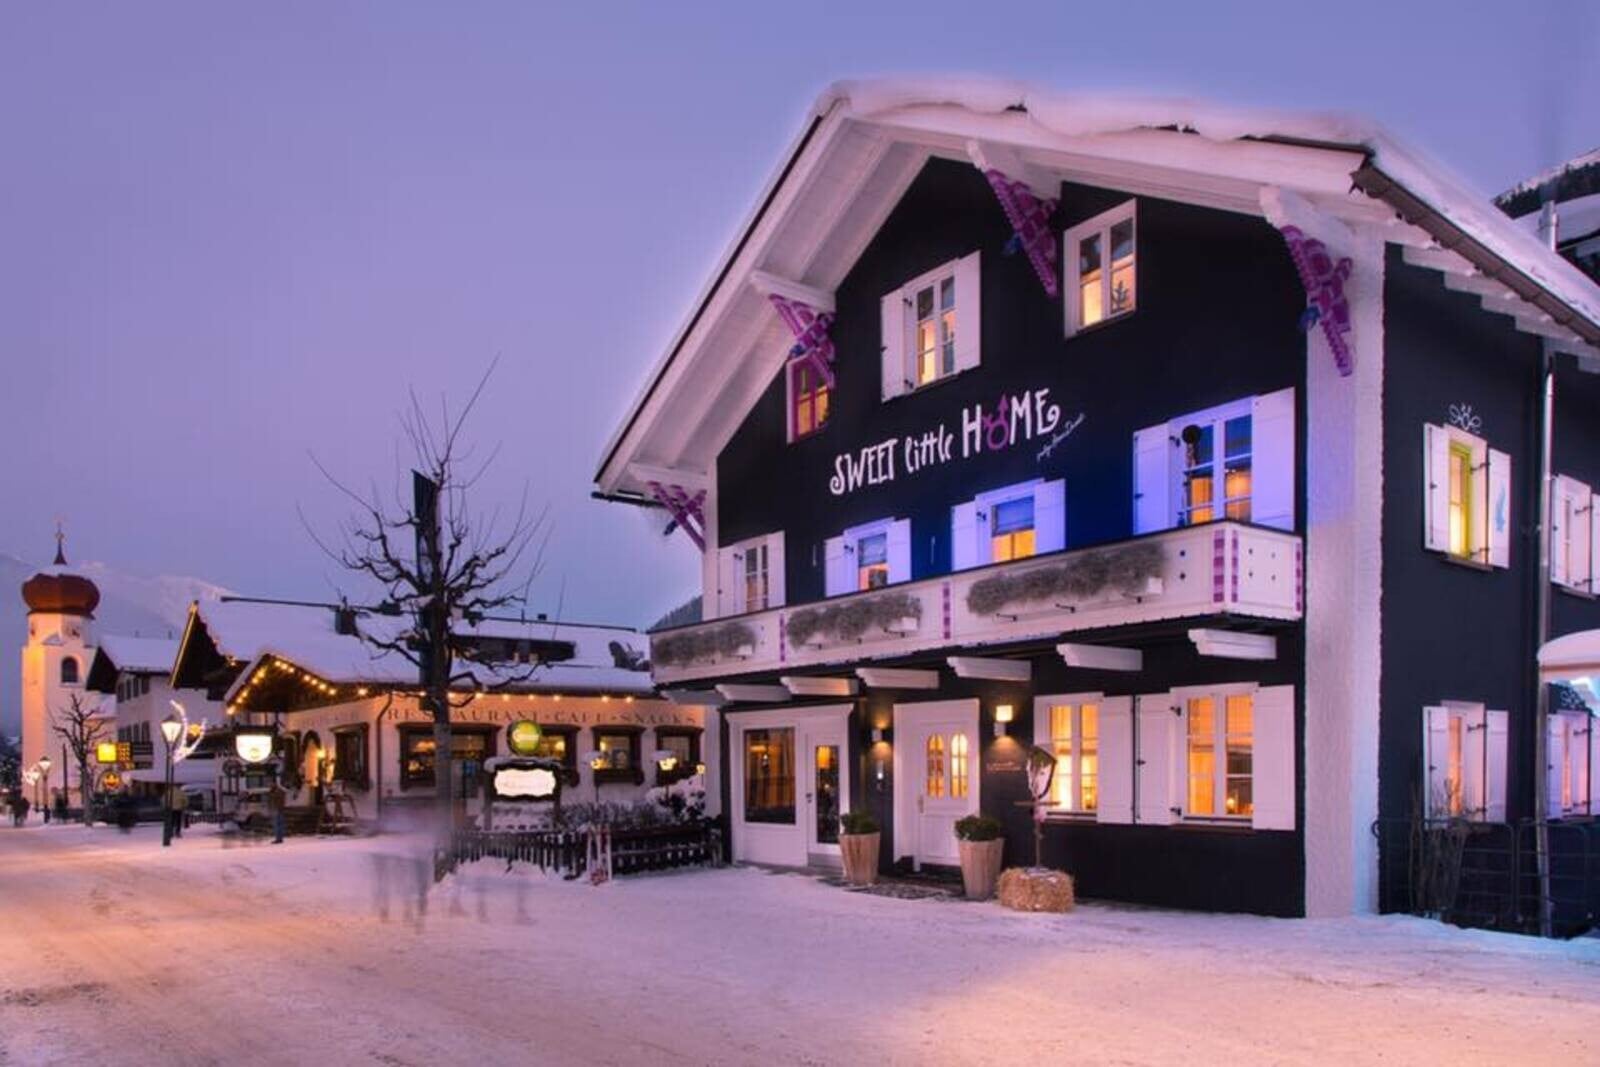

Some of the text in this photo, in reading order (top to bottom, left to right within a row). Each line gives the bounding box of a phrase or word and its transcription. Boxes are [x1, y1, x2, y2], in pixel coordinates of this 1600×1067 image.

[830, 438, 899, 495] SWEET
[905, 424, 955, 474] little
[962, 387, 1062, 459] HOME
[387, 708, 539, 723] RESAURANT
[619, 711, 697, 725] SNACKS
